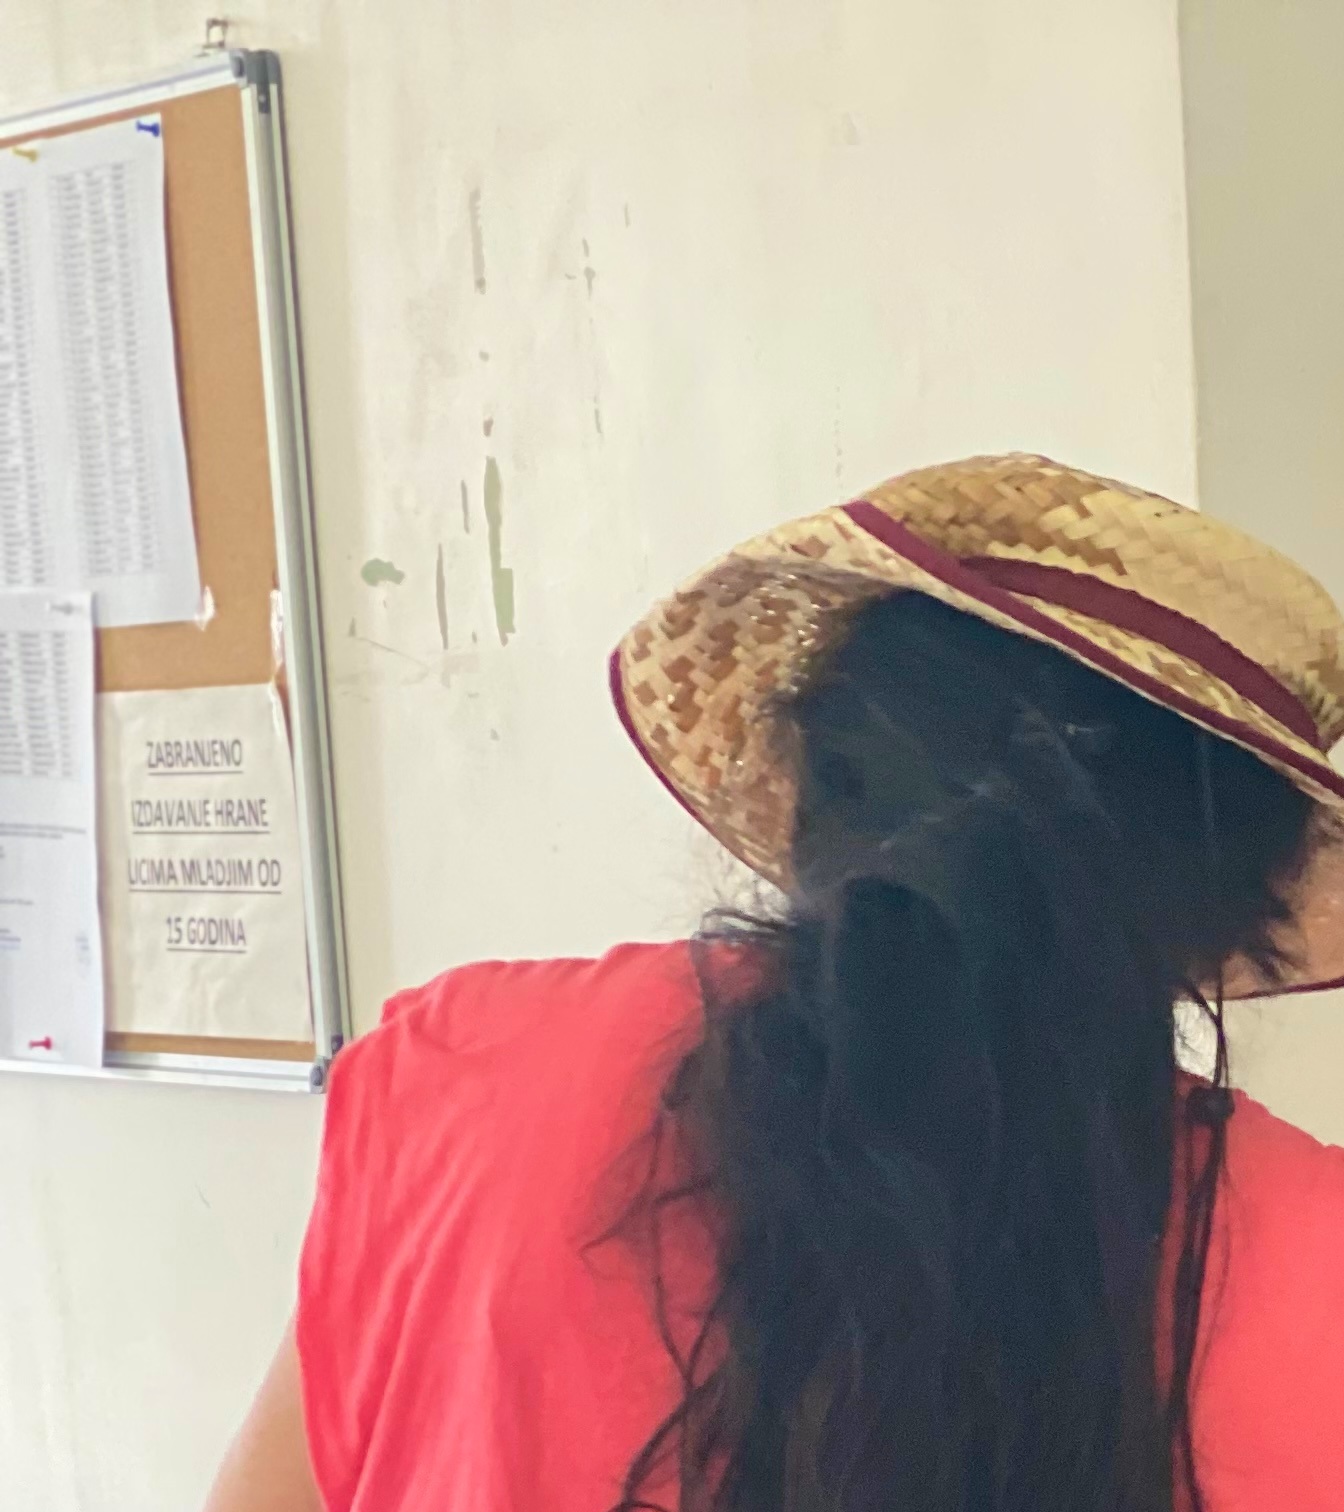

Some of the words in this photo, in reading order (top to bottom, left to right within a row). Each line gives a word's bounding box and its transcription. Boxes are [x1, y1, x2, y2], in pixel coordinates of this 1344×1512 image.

[146, 739, 242, 768] ZABRANJENO
[131, 799, 211, 827] IZDAVANJE
[215, 799, 269, 827] HRANE
[180, 858, 254, 886] MLADJIM
[258, 859, 282, 887] OD
[166, 917, 183, 944] 15
[187, 917, 247, 945] GODINA
